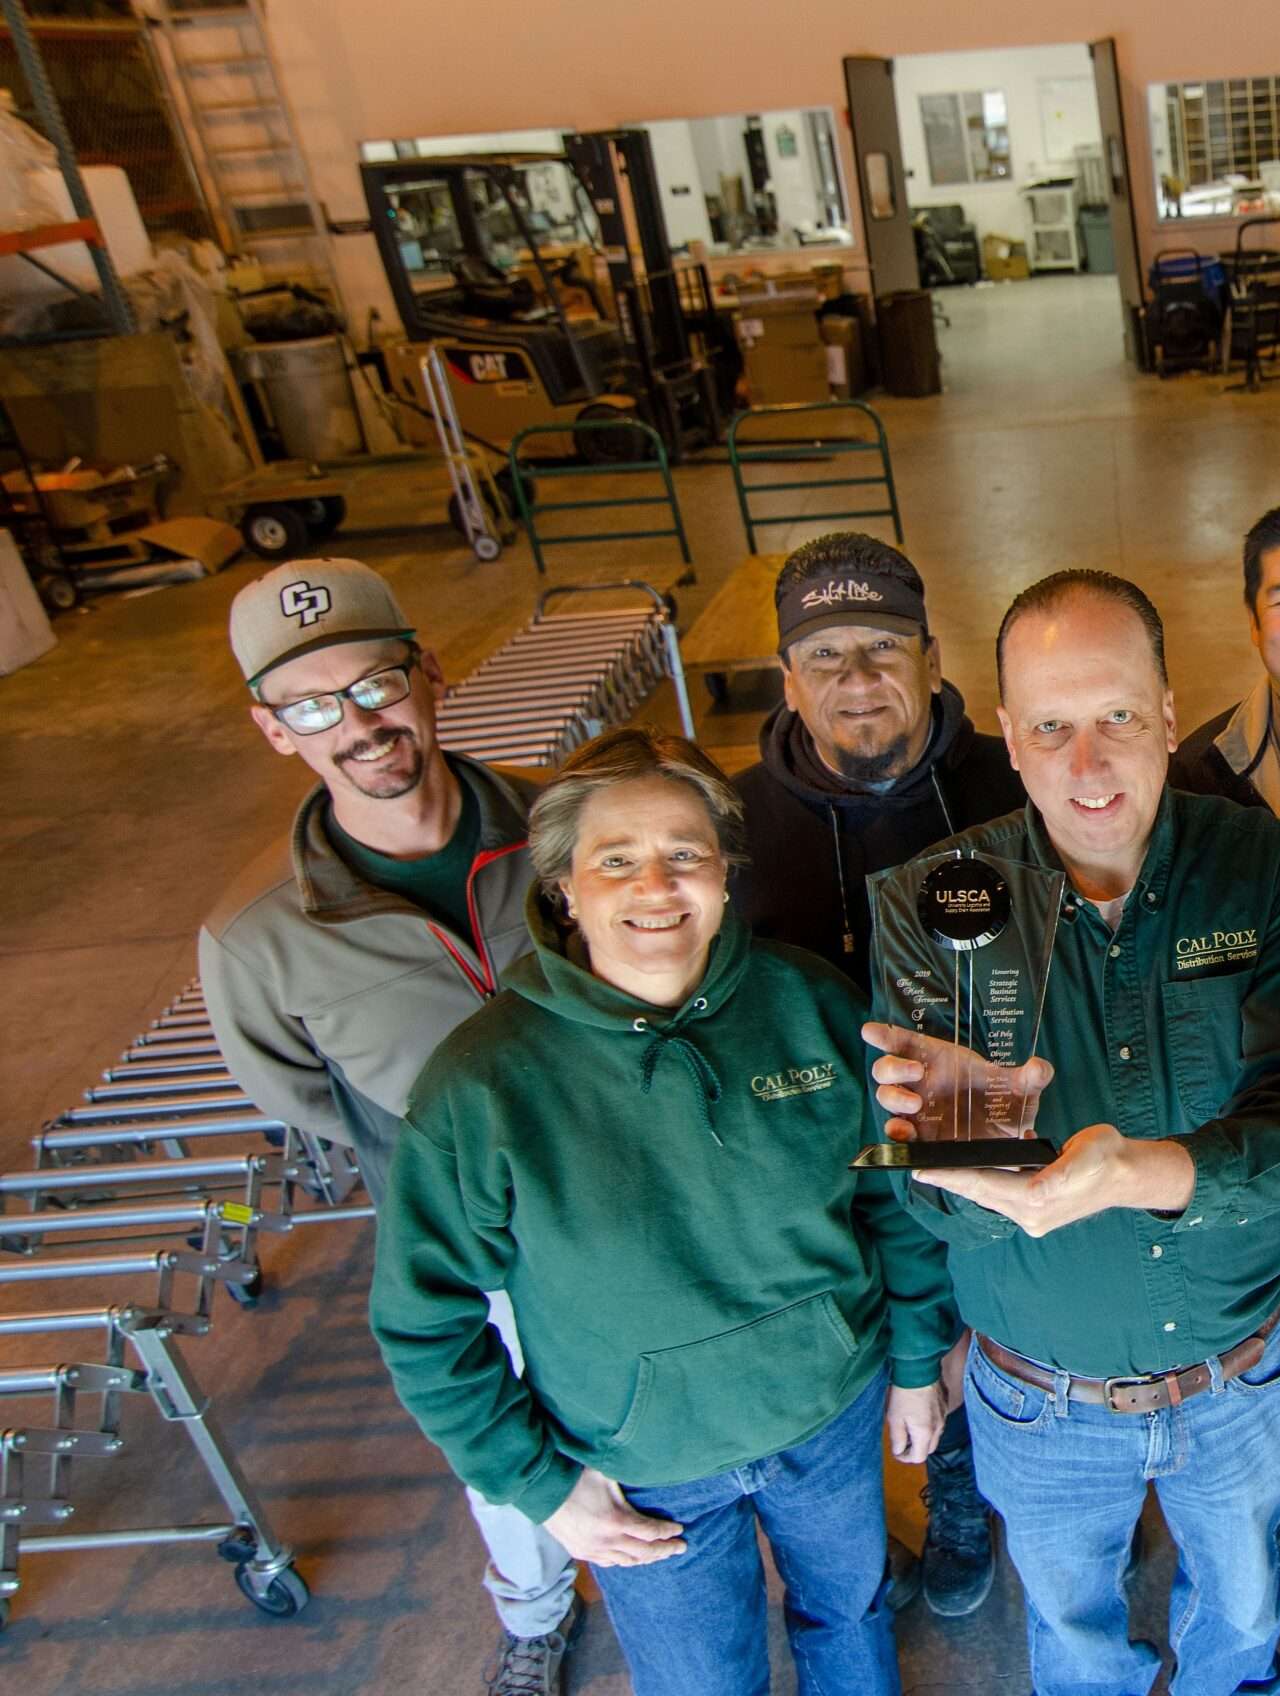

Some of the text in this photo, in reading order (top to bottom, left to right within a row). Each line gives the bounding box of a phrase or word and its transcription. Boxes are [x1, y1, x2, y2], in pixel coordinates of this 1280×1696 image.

[469, 353, 508, 381] CAT
[280, 580, 332, 628] CP
[936, 889, 991, 903] ULSCA
[1176, 937, 1212, 955] CAL
[1176, 954, 1225, 970] Distribution
[988, 979, 1018, 989] Strategic
[983, 1008, 1025, 1017] Distribution
[990, 1016, 1017, 1024] Services
[751, 1072, 788, 1093] CAL
